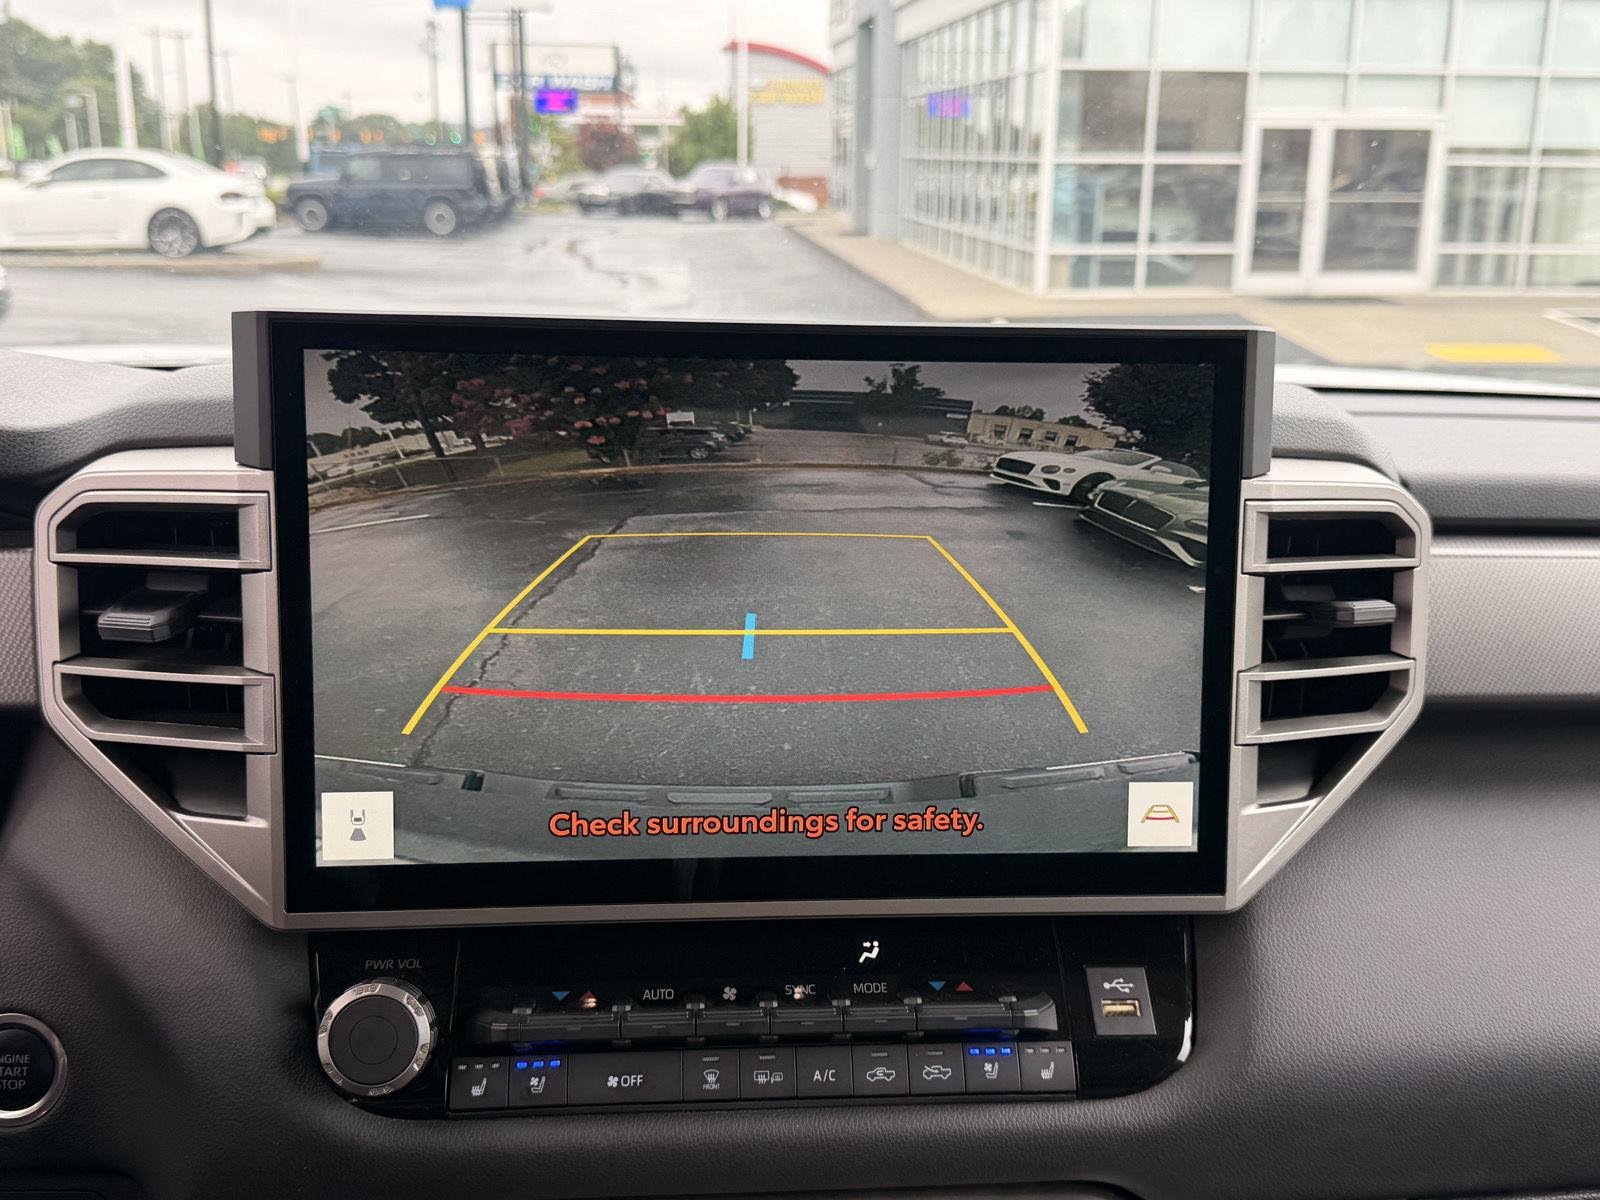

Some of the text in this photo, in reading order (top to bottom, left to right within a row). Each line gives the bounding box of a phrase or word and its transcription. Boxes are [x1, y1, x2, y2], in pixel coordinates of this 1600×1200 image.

[549, 806, 985, 839] Check surroundings for safety.
[364, 958, 422, 969] PWR VOL
[642, 988, 675, 1000] AUTO
[784, 983, 817, 996] SYNC
[853, 982, 888, 994] MODE
[0, 1054, 31, 1064] NGINE
[0, 1066, 28, 1077] TART
[813, 1069, 836, 1082] A/C
[0, 1079, 27, 1090] TOP
[620, 1074, 644, 1088] OFF
